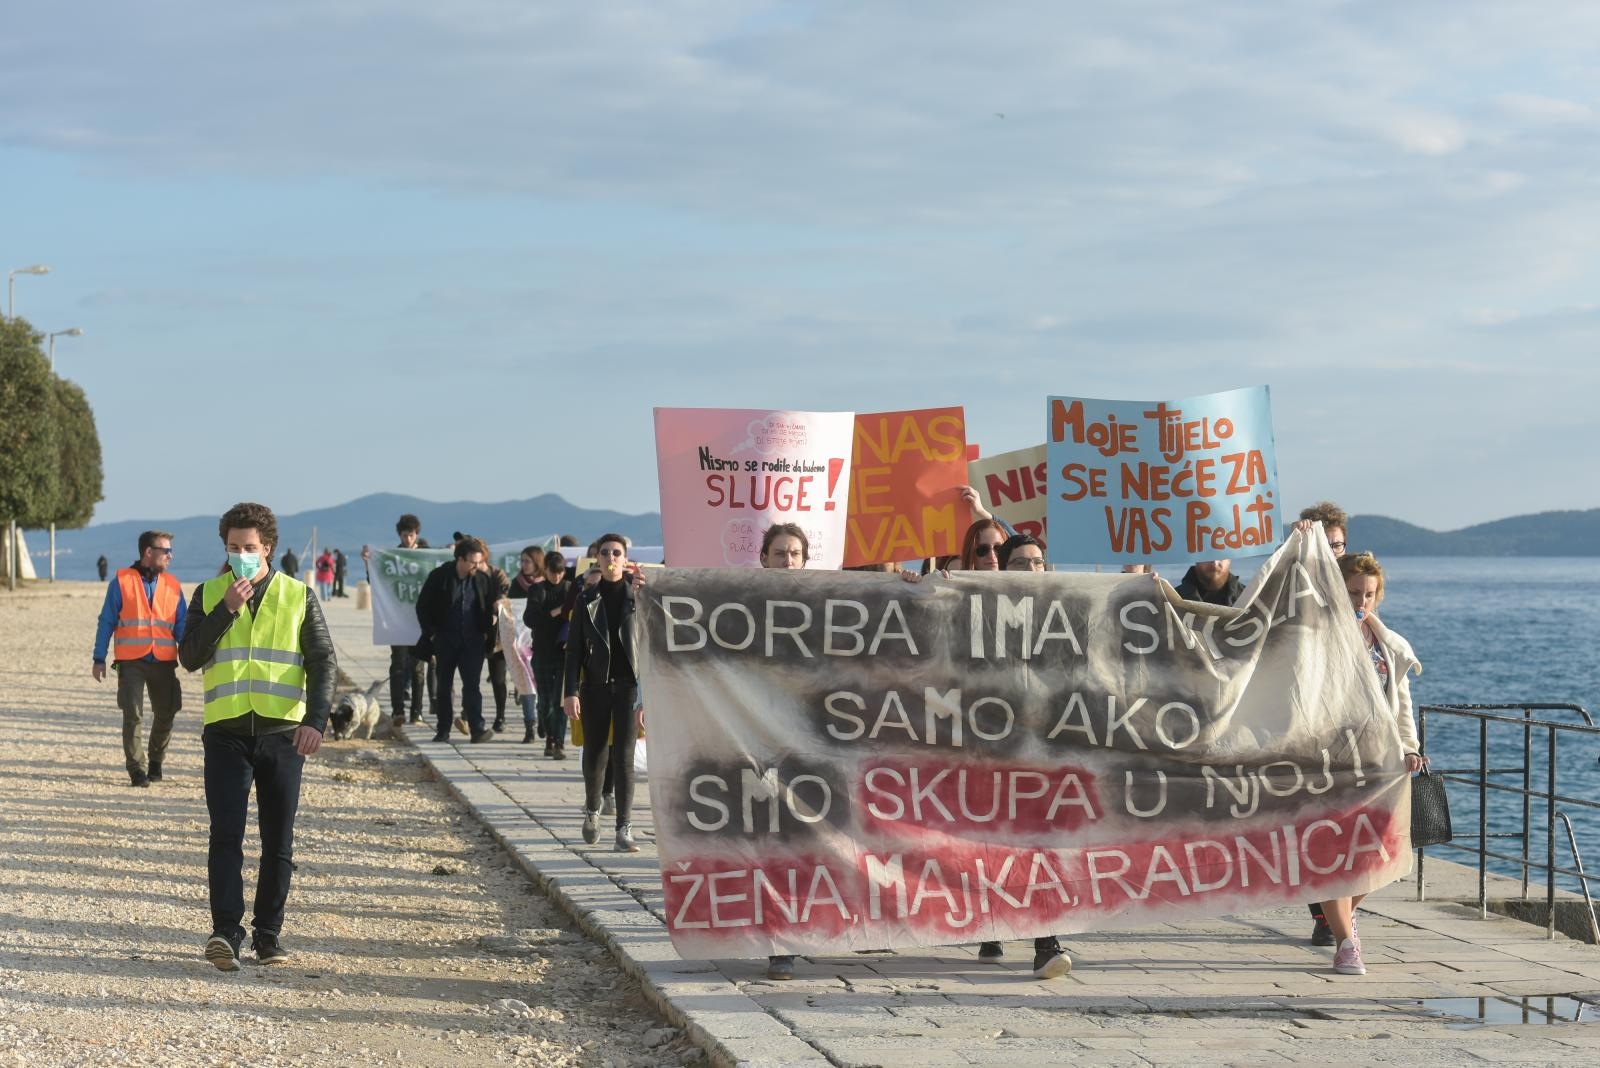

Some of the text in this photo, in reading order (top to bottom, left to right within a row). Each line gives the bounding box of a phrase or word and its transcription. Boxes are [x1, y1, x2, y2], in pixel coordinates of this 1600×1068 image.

[698, 446, 739, 471] Nismo
[744, 459, 758, 472] se
[802, 459, 826, 472] budemo
[853, 415, 964, 464] NAS
[1061, 449, 1267, 501] SE NEĆE ZA
[848, 503, 956, 562] VAM
[1104, 505, 1173, 554] VAS
[661, 596, 919, 658] BORBA
[969, 594, 1083, 659] IMA
[824, 686, 1201, 750] SAMO AKO
[686, 767, 832, 832] SMO
[864, 767, 1096, 822] SKUPA
[1125, 770, 1169, 818] U
[1086, 813, 1391, 905] RADNICA
